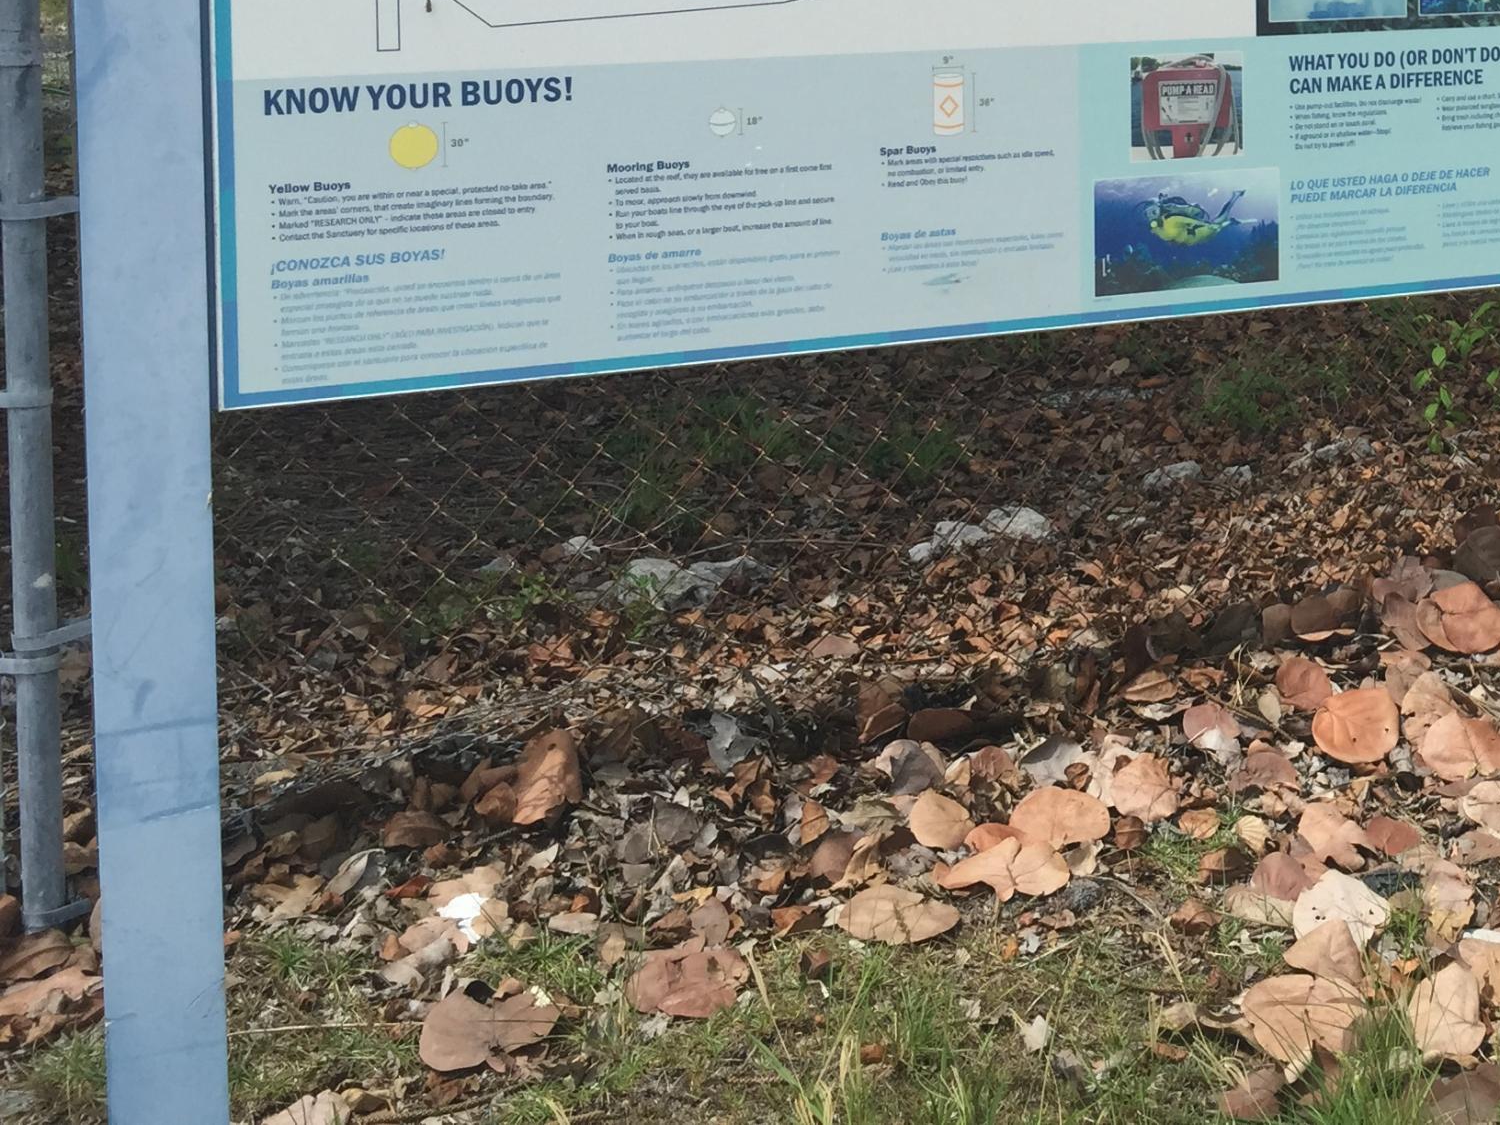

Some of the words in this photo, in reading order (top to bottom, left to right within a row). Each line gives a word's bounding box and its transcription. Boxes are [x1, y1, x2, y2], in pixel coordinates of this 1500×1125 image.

[1289, 54, 1334, 71] WHAT
[1337, 52, 1368, 68] YOU
[1374, 51, 1395, 67] DO
[1400, 49, 1427, 69] (OR
[1432, 47, 1476, 64] DON'T
[1162, 84, 1186, 96] PUMP
[1186, 85, 1191, 94] A
[1193, 84, 1214, 95] HEAD
[1289, 77, 1321, 94] CAN
[1327, 74, 1372, 92] MAKE
[1375, 74, 1385, 89] A
[1390, 69, 1482, 88] DIFFERENCE
[264, 86, 359, 115] KNOW
[366, 82, 451, 110] YOUR
[461, 76, 571, 106] BUOYS!
[879, 147, 903, 157] Spar
[906, 145, 936, 154] Buoys
[607, 162, 653, 172] Mooring
[656, 160, 689, 170] Buoys
[268, 183, 309, 193] Yellow
[313, 181, 350, 191] Buoys
[1290, 180, 1304, 190] LO
[1307, 178, 1329, 190] QUE
[1332, 175, 1366, 187] USTED
[1369, 173, 1398, 184] HAGA
[1401, 173, 1408, 182] O
[1411, 170, 1436, 181] DEJE
[1438, 169, 1453, 179] DE
[1455, 167, 1490, 178] HACER
[1290, 191, 1326, 203] PUEDE
[1329, 188, 1376, 200] MARCAR
[1379, 186, 1392, 196] LA
[1395, 182, 1456, 195] DIFERENCIA
[880, 232, 911, 241] Boyas
[928, 228, 956, 237] astas
[270, 255, 350, 275] ¡CONOZCA
[354, 253, 385, 266] SUS
[390, 248, 445, 263] BOYAS!
[608, 253, 641, 263] Boyas
[661, 249, 701, 258] amarre
[271, 279, 308, 290] Boyas
[312, 273, 369, 286] amarillas
